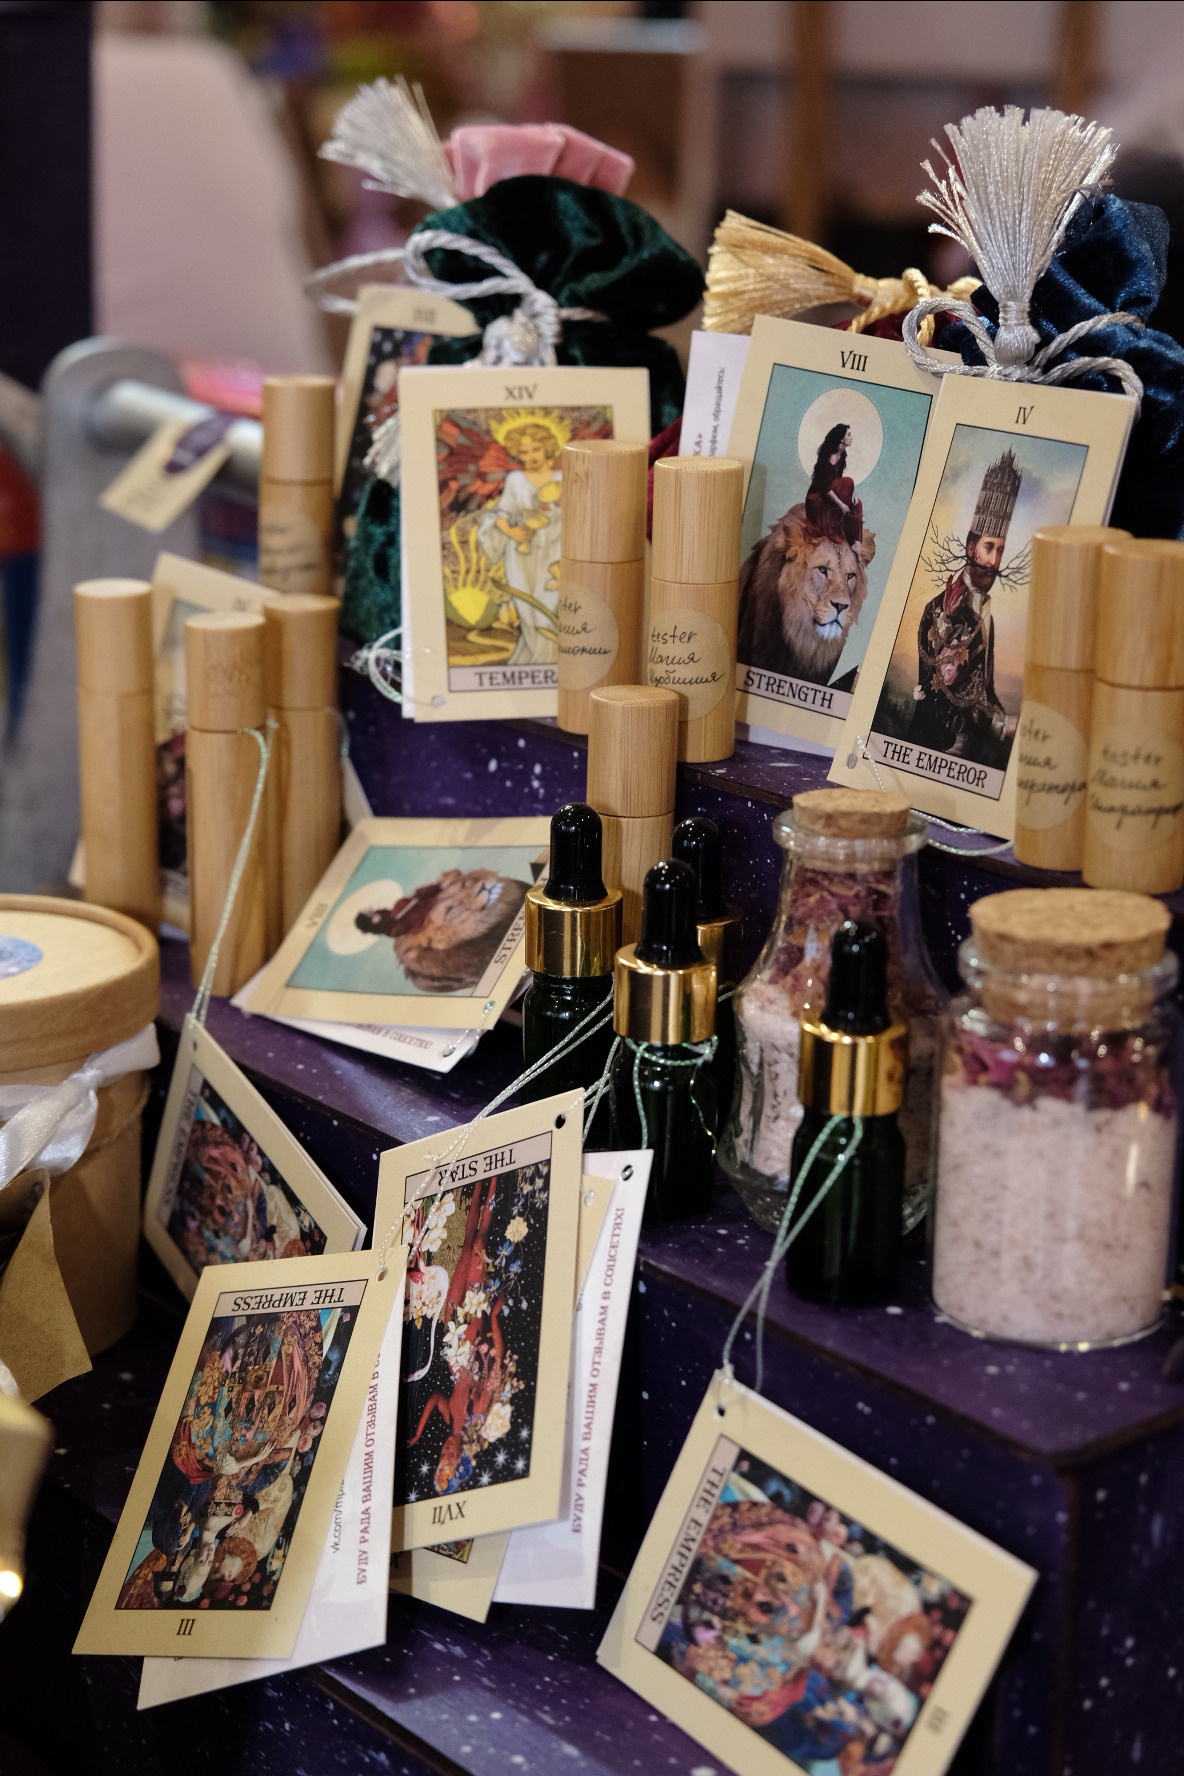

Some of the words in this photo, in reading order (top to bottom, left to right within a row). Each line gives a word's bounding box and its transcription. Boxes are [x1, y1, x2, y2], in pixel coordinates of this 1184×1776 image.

[839, 350, 868, 372] VIII
[504, 384, 538, 401] XIV
[1015, 405, 1033, 425] IV
[651, 624, 697, 645] tester
[474, 670, 559, 687] TEMPER
[743, 671, 834, 710] STRENGTH
[883, 740, 913, 767] THE
[915, 751, 987, 789] EMPEROR
[437, 1157, 478, 1185] STAR
[482, 1147, 517, 1172] THE
[603, 1206, 625, 1287] СОЦСЕТЯХ!
[231, 1288, 309, 1312] EMPRESS
[316, 1284, 345, 1305] THE
[601, 1290, 611, 1300] В
[589, 1305, 609, 1378] ОТЗЫВАМ
[363, 1383, 379, 1448] ОТЗЫВАМ
[581, 1382, 598, 1442] ВАШИМ
[361, 1451, 375, 1503] ВАШИМ
[576, 1446, 591, 1488] РАДА
[694, 1465, 727, 1514] THE
[330, 1480, 346, 1555] vk.com/mp
[358, 1506, 372, 1545] РАДА
[431, 1501, 467, 1526] XVII
[571, 1493, 585, 1534] БУДУ
[355, 1549, 369, 1586] БУДУ
[650, 1518, 704, 1626] EMPRESS
[176, 1617, 197, 1637] III
